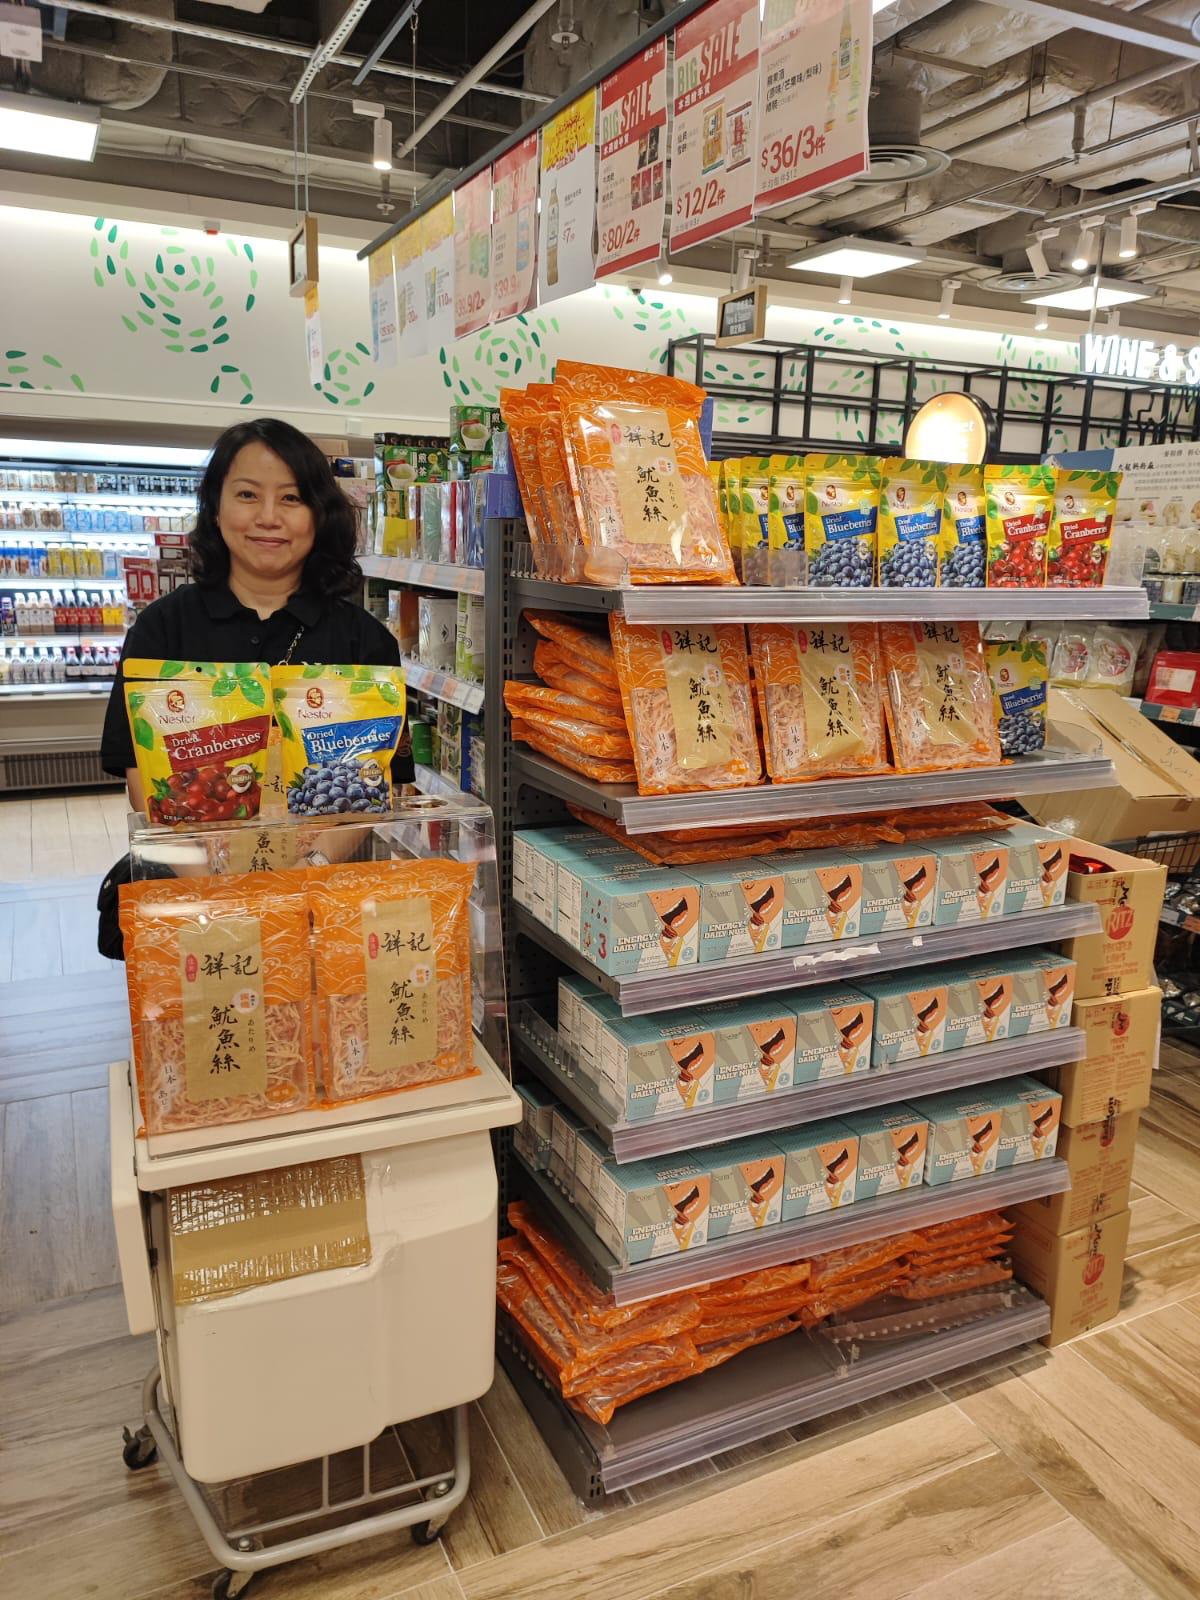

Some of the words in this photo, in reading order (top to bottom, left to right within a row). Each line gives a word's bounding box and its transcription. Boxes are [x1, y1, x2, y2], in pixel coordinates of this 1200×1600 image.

[678, 58, 698, 95] BIG
[699, 21, 742, 83] SALE
[603, 110, 620, 144] BIG
[620, 79, 654, 134] SALE
[1082, 333, 1156, 379] WINE
[1159, 344, 1183, 382] &
[623, 425, 671, 448] 祥記
[827, 519, 872, 534] Blueberries
[900, 522, 938, 535] Blueberries
[674, 630, 718, 654] 祥記
[809, 630, 850, 654] 祥記
[159, 714, 197, 726] Nestor
[298, 709, 333, 720] Nestor
[688, 676, 717, 743] 魷魚絲
[818, 676, 849, 738] 魷魚絲
[171, 731, 202, 748] Dried
[174, 732, 261, 761] Cranberries
[307, 729, 334, 741] Dried
[311, 729, 391, 754] Blueberries
[381, 929, 431, 957] 祥記
[200, 952, 259, 980] 祥記
[388, 979, 416, 1046] 魷魚絲
[209, 1003, 241, 1075] 魷魚絲
